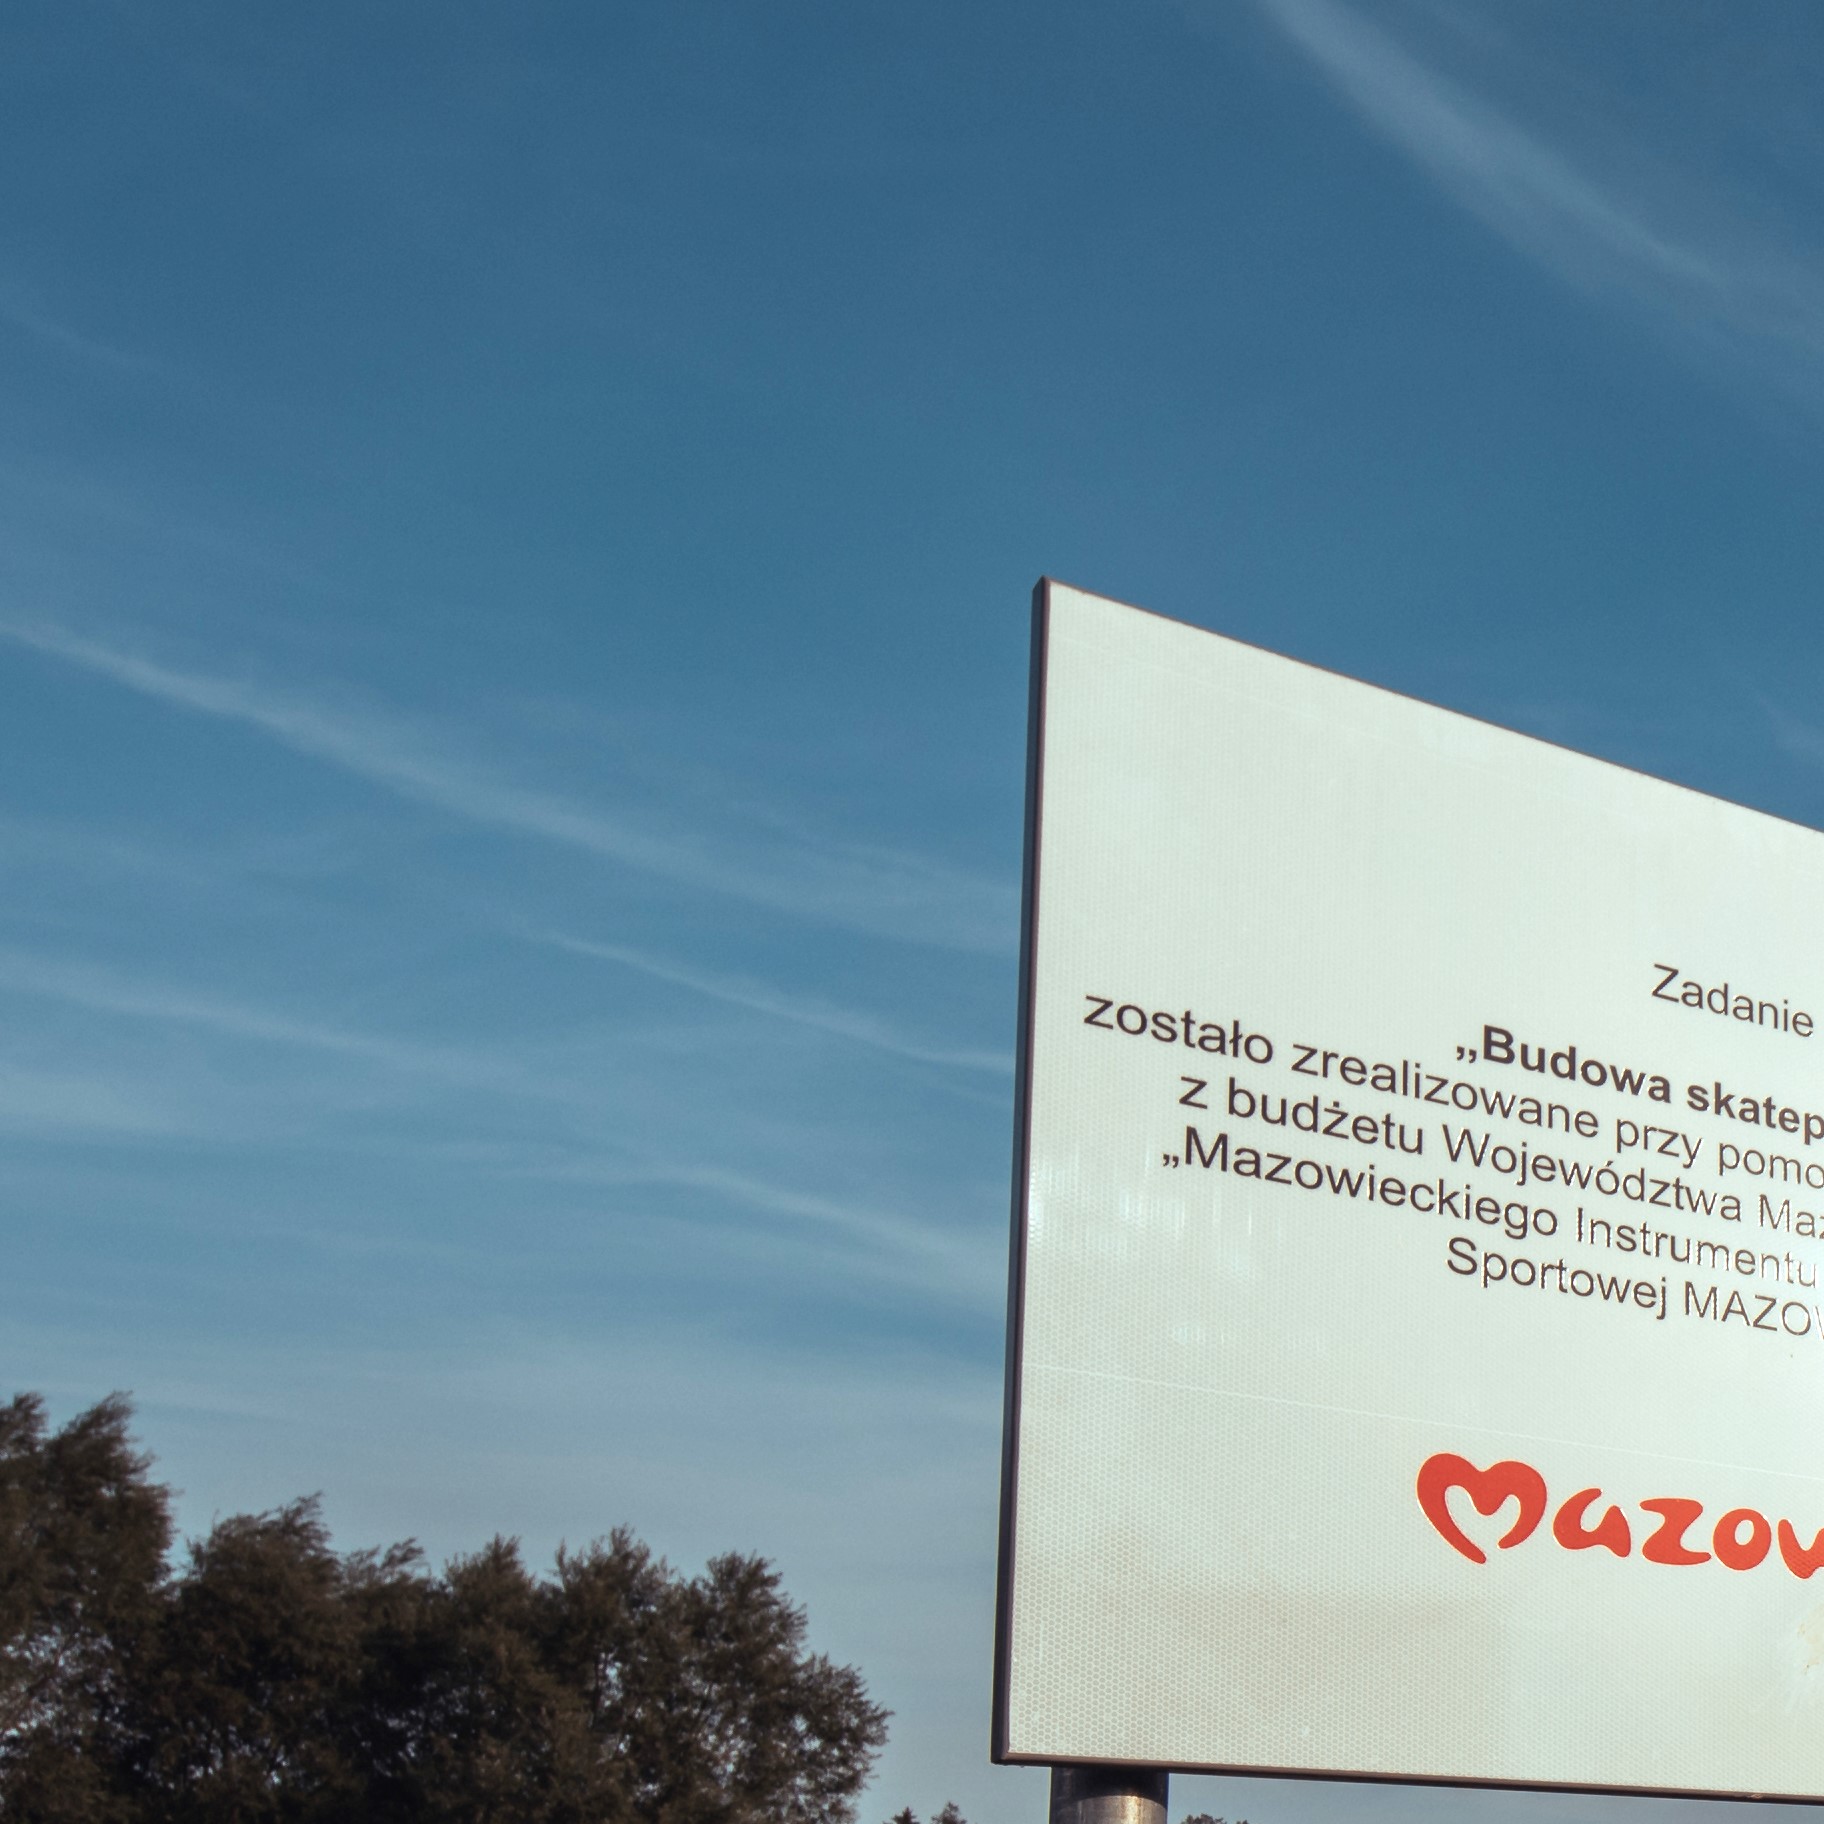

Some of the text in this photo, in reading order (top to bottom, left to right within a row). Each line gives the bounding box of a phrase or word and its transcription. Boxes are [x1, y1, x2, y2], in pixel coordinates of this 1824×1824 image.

[1651, 964, 1814, 1038] Zadanie
[1084, 995, 1274, 1065] zostało
[1291, 1043, 1600, 1139] zrealizowane
[1615, 1118, 1703, 1169] przy
[1455, 1024, 1671, 1104] „Budowa
[1161, 1125, 1559, 1241] „Mazowieckiego
[1577, 1207, 1817, 1288] Instrumentu
[1179, 1076, 1209, 1110] z
[1228, 1077, 1424, 1155] budżetu
[1442, 1124, 1742, 1222] Województwa
[1447, 1236, 1666, 1320] Sportowej
